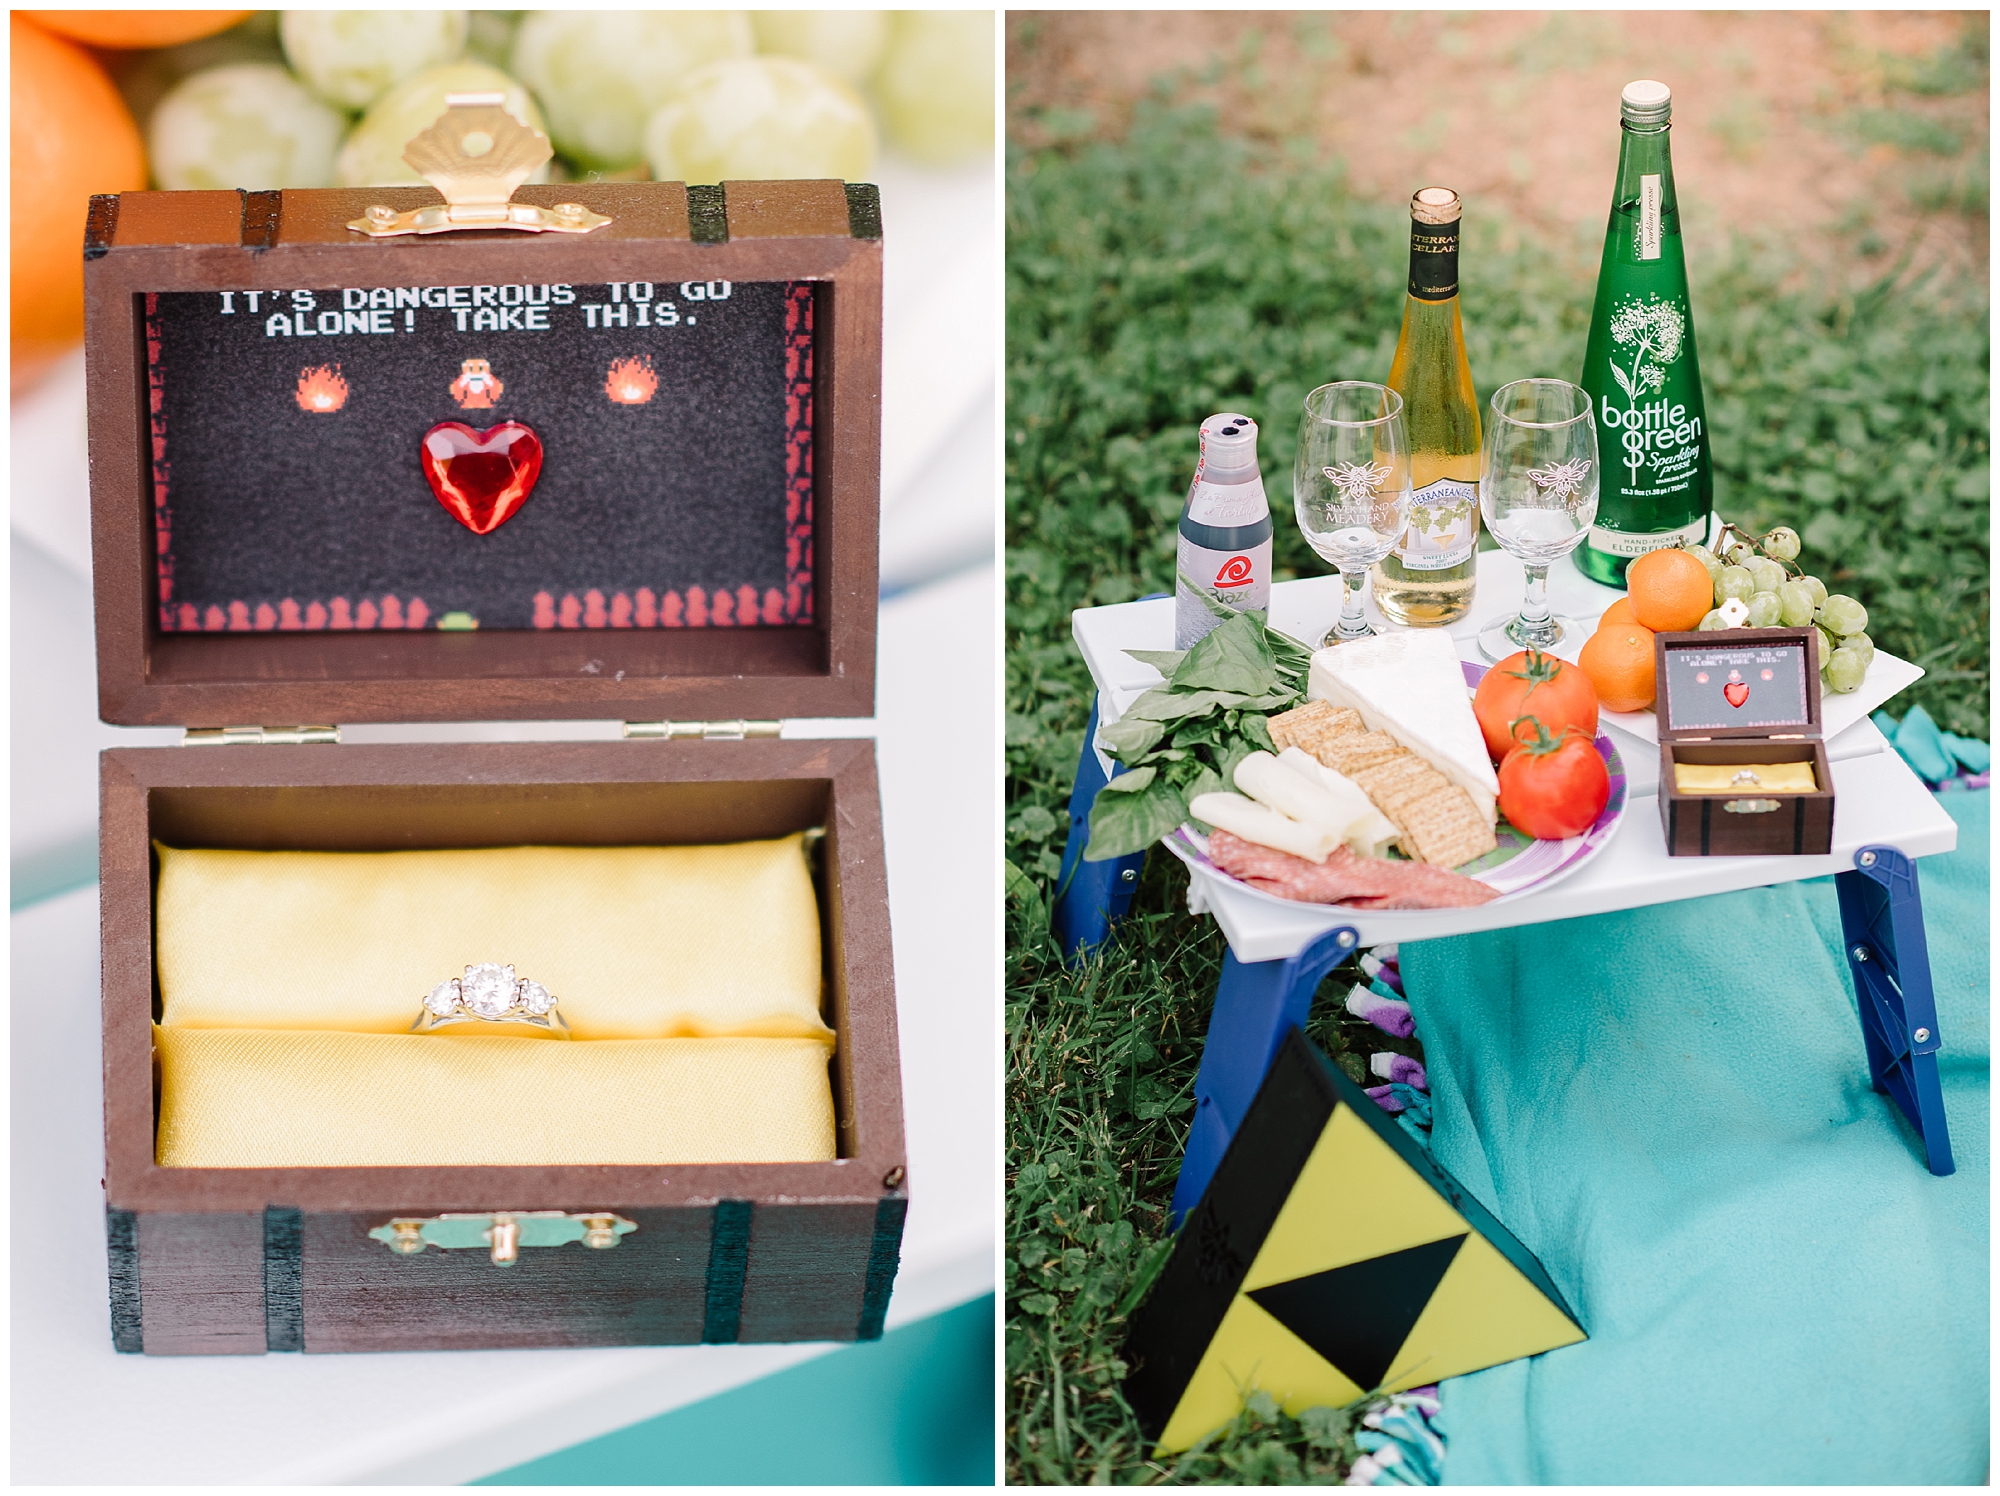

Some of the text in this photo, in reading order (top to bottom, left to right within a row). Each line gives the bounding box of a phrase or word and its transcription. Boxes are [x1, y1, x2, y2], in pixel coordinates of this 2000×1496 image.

[219, 280, 733, 315] IT'S DANGEROUS TO GO
[265, 302, 698, 337] ALONE! TAKE THIS.
[1602, 395, 1686, 429] bottle
[1622, 416, 1702, 468] green
[1646, 445, 1700, 472] Sparkling
[1325, 502, 1357, 514] SILVER
[1360, 502, 1389, 512] HAND
[1325, 511, 1389, 525] MEADERY
[1624, 534, 1682, 545] HAND-PICKED
[1680, 655, 1701, 663] IT'S
[1706, 652, 1755, 661] DANGEROUS
